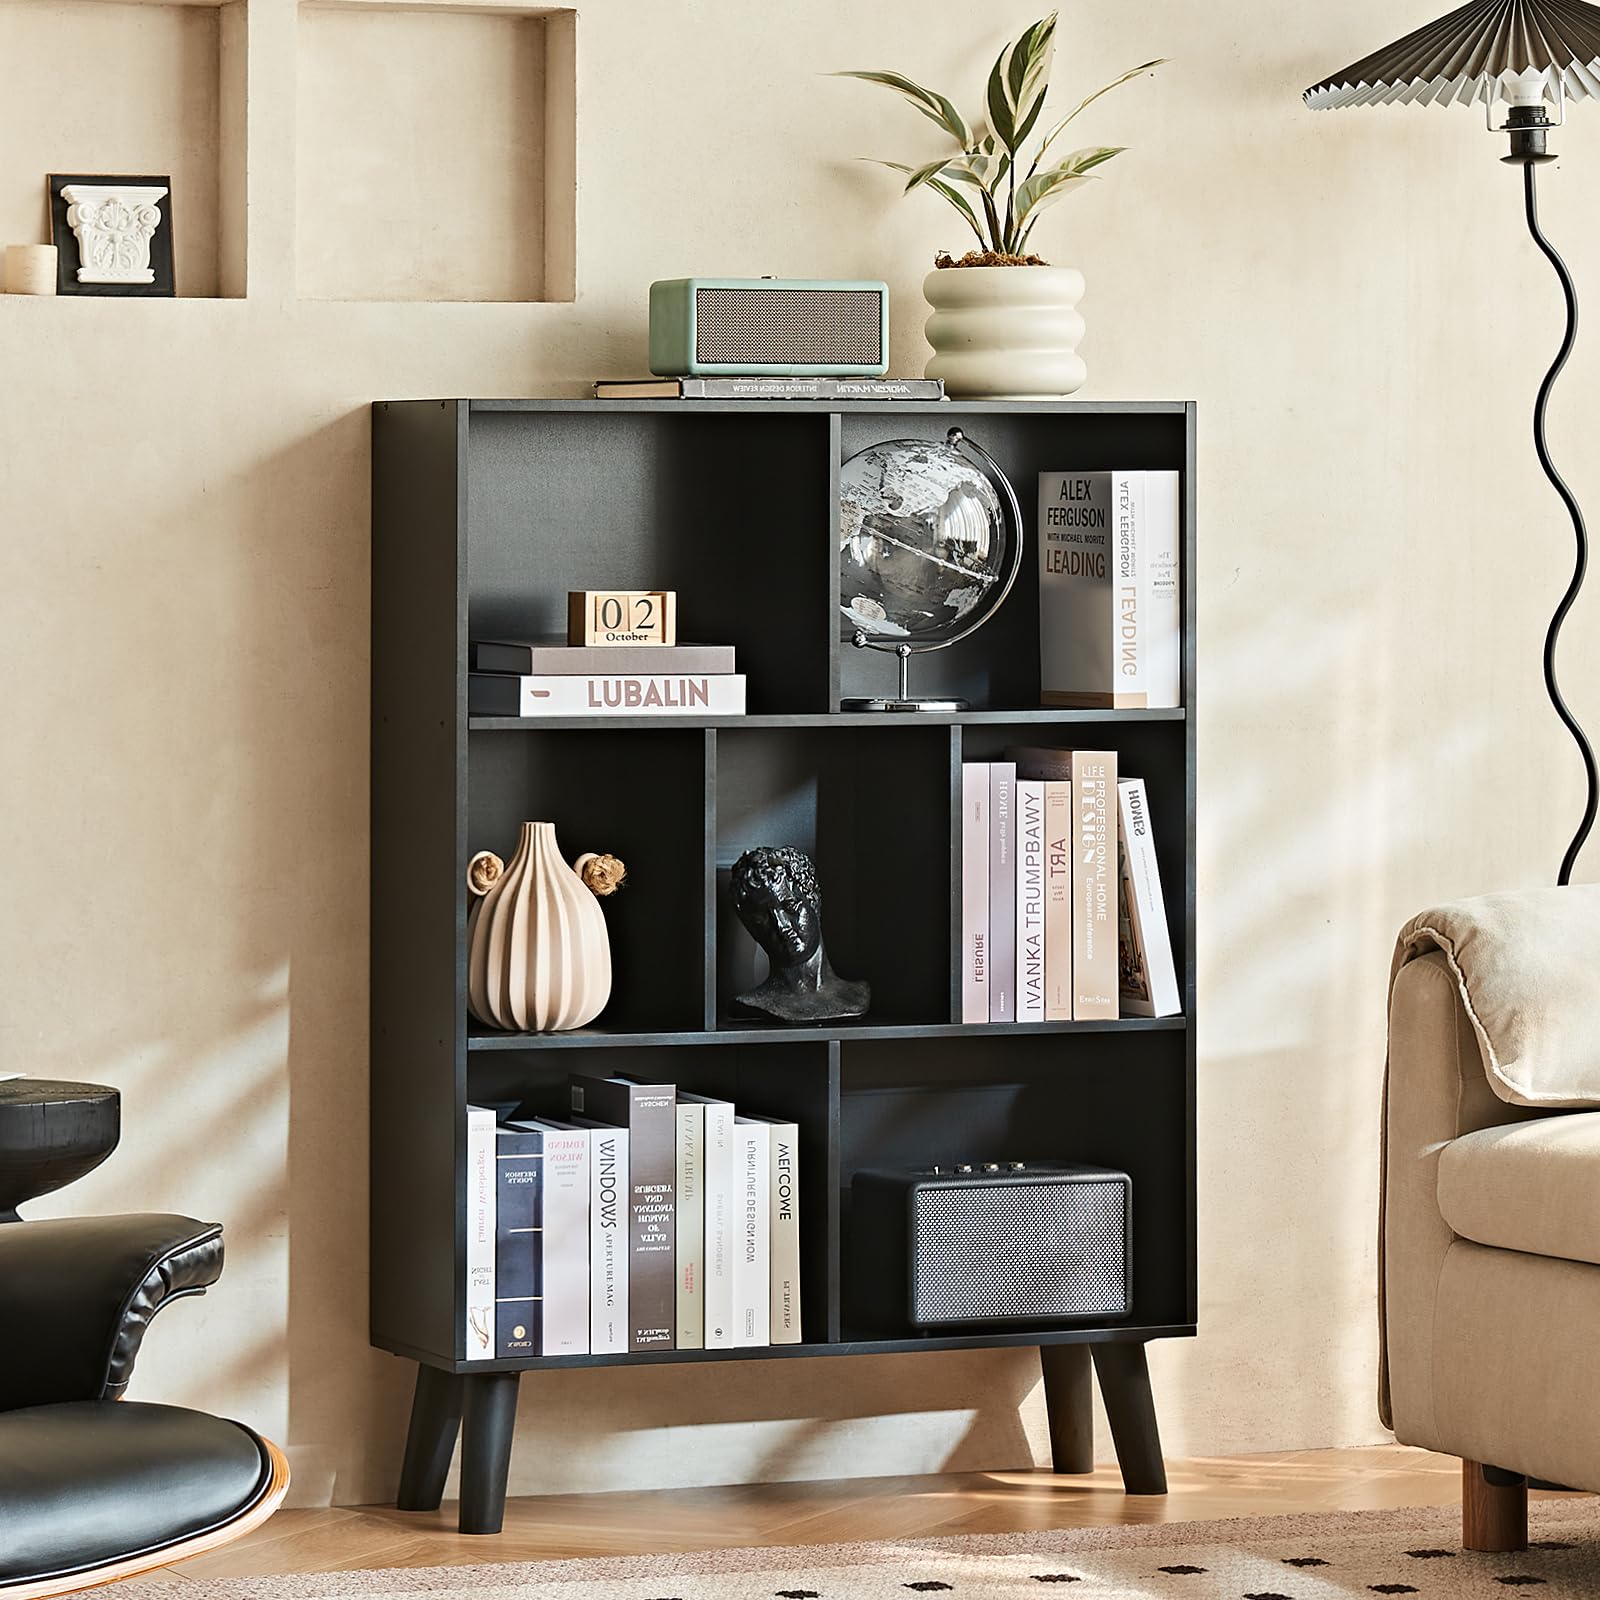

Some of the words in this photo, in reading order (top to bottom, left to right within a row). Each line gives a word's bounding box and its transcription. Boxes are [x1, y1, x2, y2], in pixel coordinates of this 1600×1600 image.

[1060, 480, 1092, 501] ALEX
[1047, 507, 1105, 528] FERGUSON
[1061, 533, 1083, 544] MICHAEL
[1084, 535, 1105, 545] MORITZ
[1046, 549, 1106, 579] LEADING
[606, 632, 649, 642] October
[588, 679, 709, 708] LUBALIN
[1082, 766, 1105, 777] LIFE
[1096, 780, 1106, 881] PROFESSIONAL
[1025, 792, 1041, 929] TRUMPBAWY
[1086, 877, 1094, 918] European
[1097, 883, 1107, 921] HOME
[1086, 919, 1094, 960] reference
[1026, 934, 1041, 1010] IVANKA
[599, 1139, 617, 1229] WINDOWS
[606, 1232, 614, 1282] APERTURE
[606, 1284, 614, 1307] MAG
